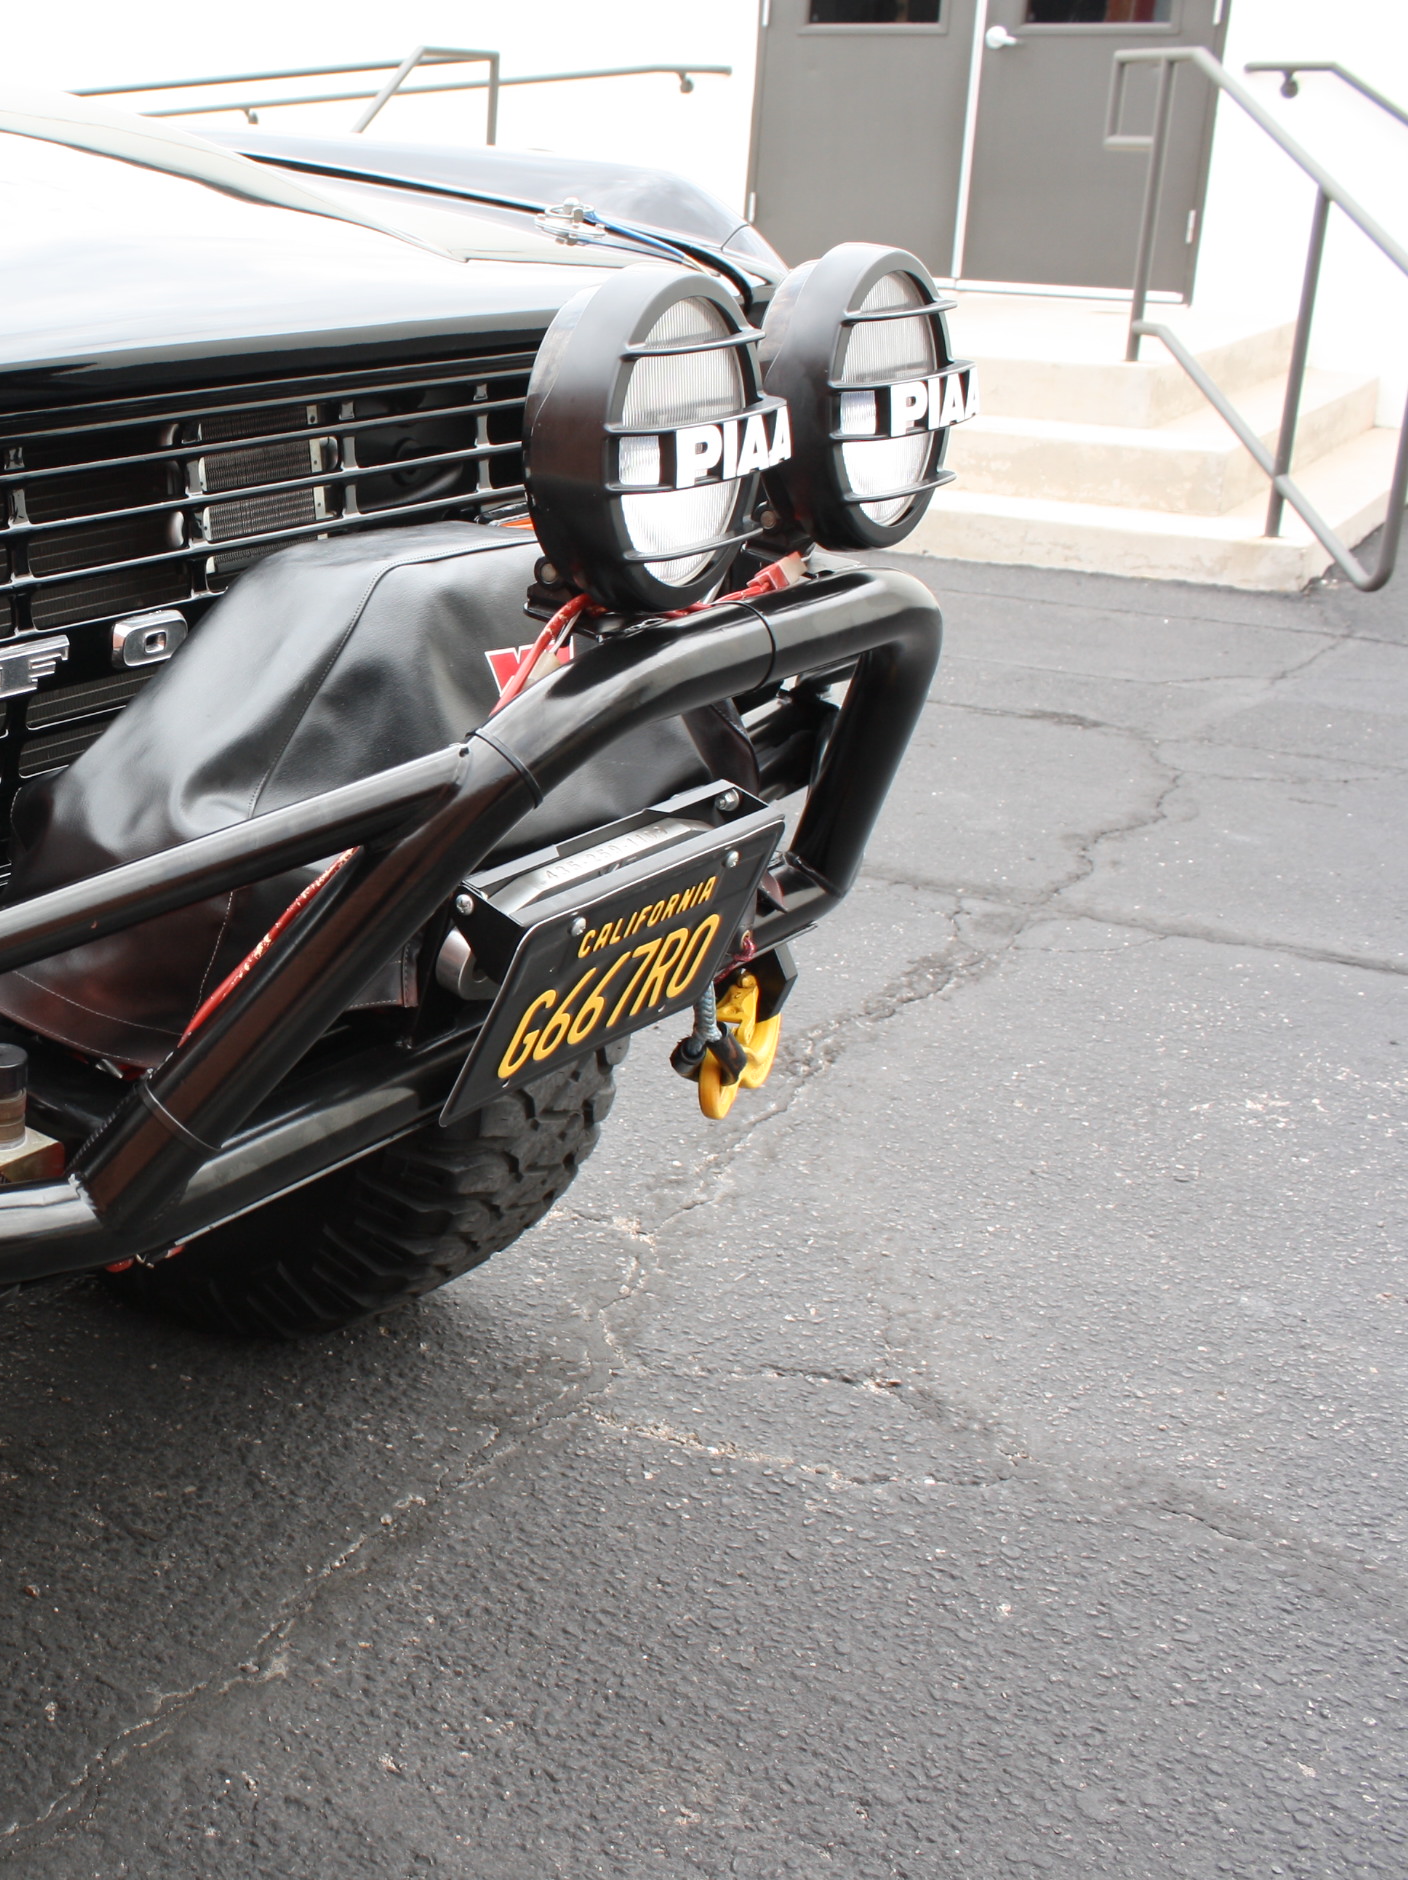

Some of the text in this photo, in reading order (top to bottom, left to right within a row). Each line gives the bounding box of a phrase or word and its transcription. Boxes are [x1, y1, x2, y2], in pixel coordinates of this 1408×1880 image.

[891, 365, 981, 437] PIAA
[675, 406, 793, 489] PIAA
[578, 876, 717, 959] CALIFORNIA
